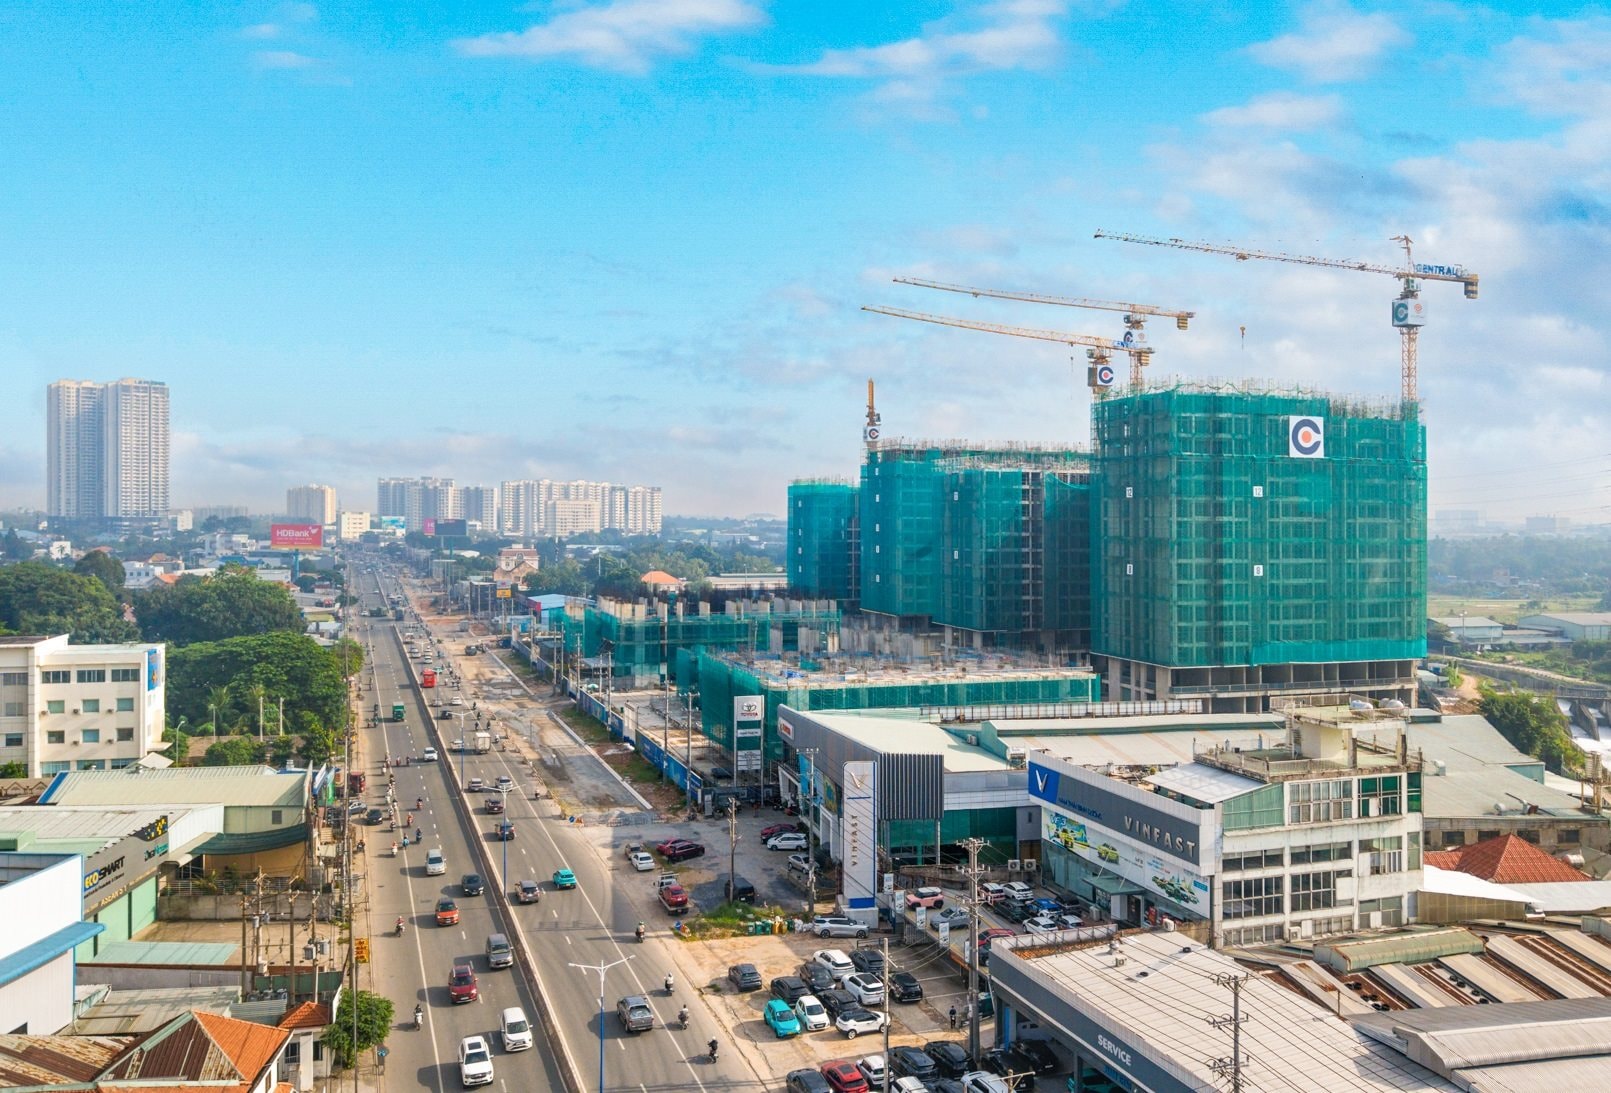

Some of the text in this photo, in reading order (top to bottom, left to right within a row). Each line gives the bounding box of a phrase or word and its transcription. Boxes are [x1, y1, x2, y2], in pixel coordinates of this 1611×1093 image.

[276, 529, 310, 537] HDBank
[1124, 815, 1196, 858] VINFAST
[1097, 1034, 1132, 1066] SERVICE
